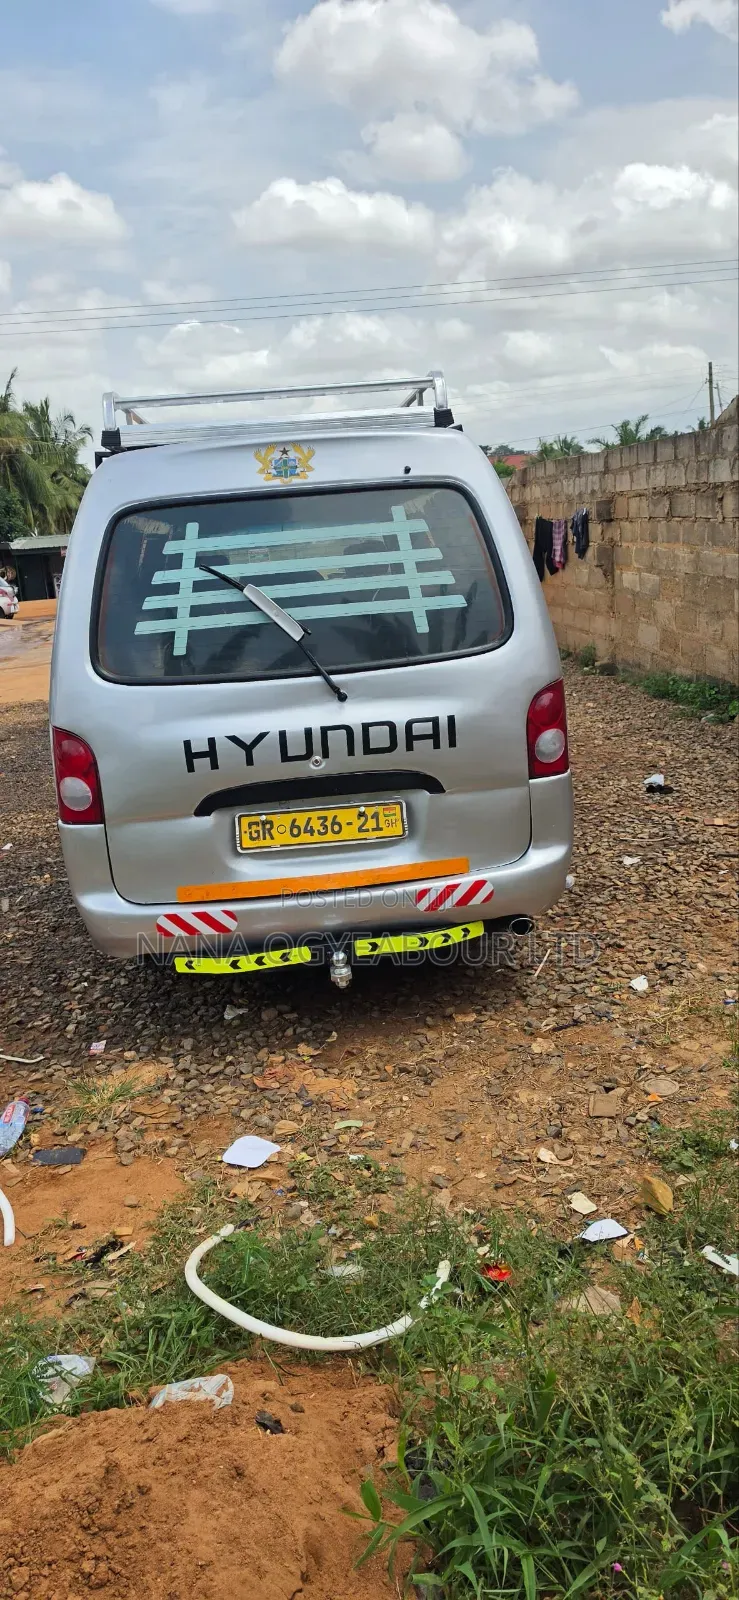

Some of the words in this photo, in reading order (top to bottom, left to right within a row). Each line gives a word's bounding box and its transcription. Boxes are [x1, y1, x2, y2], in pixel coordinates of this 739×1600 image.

[183, 715, 457, 773] HYUNDAI
[248, 820, 275, 841] GR
[385, 818, 397, 828] GH
